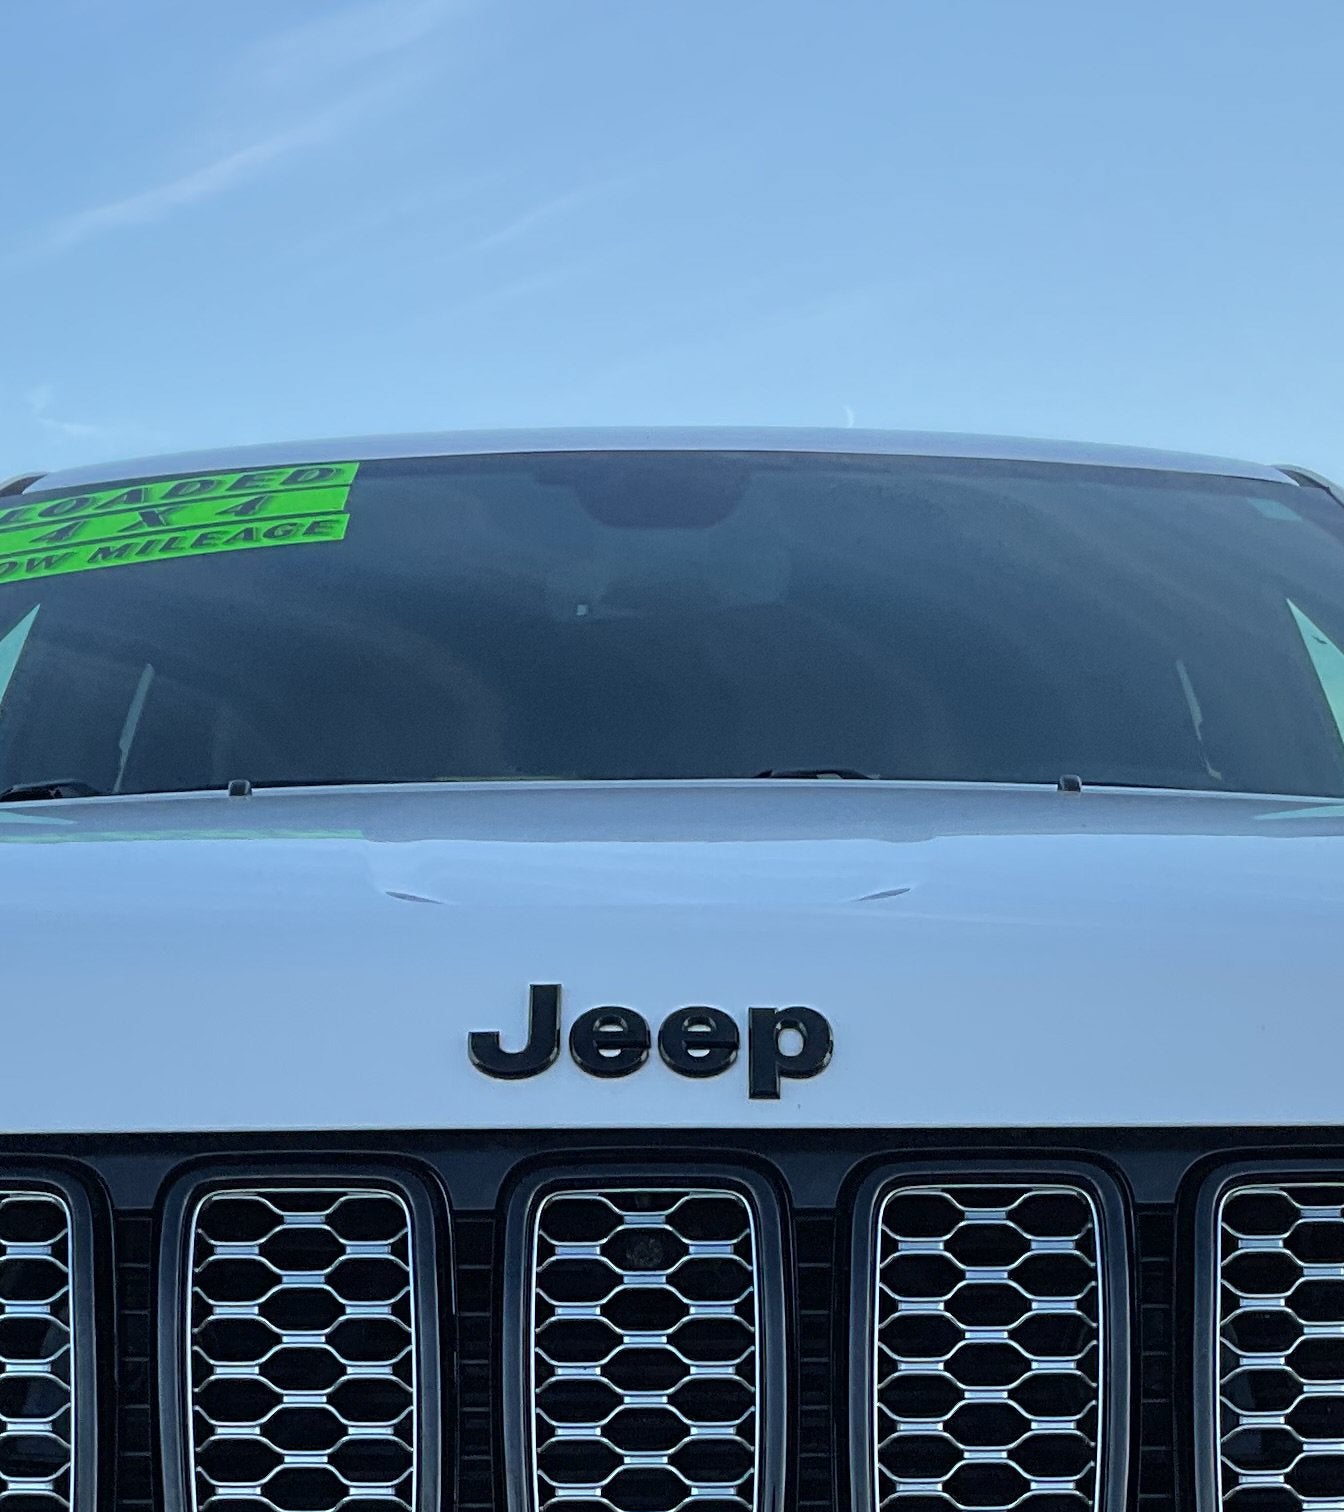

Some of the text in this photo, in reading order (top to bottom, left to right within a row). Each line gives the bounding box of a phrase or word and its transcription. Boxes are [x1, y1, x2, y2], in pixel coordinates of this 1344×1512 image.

[29, 519, 89, 546] 4
[217, 494, 275, 518] 4
[86, 518, 340, 564] MILEAGE
[467, 983, 834, 1101] Jeep
